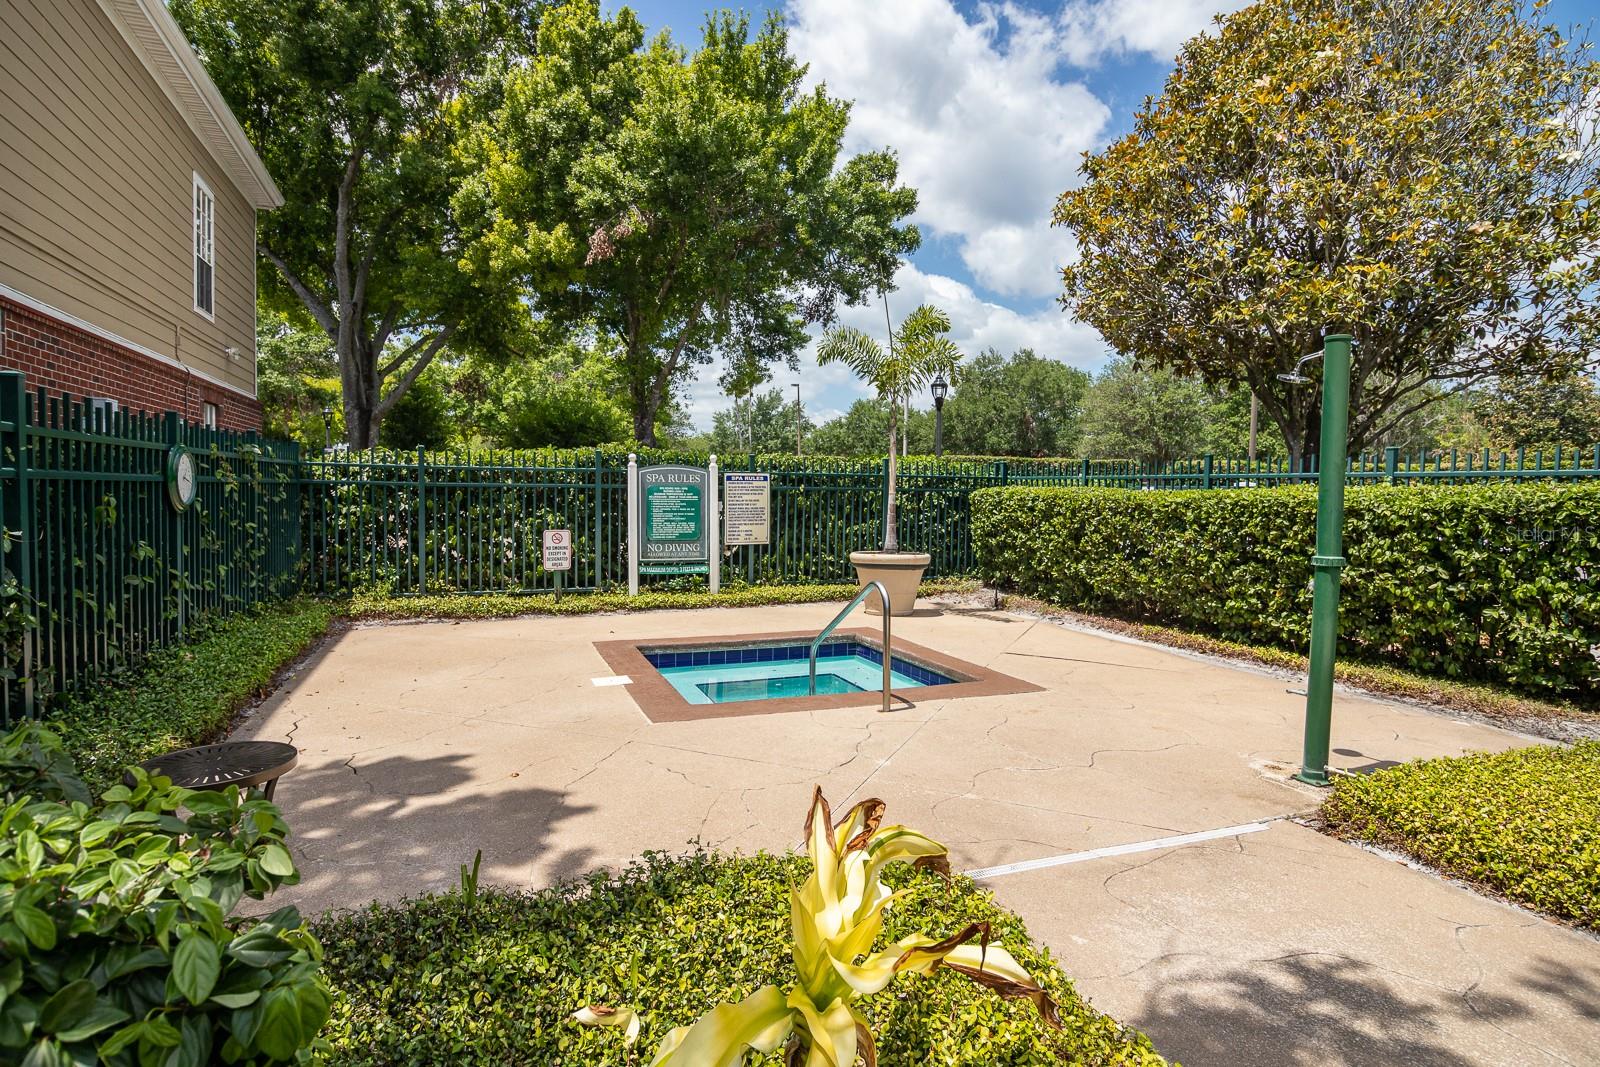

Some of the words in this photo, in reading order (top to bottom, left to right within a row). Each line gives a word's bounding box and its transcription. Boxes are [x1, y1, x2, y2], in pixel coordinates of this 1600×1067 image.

[646, 473, 665, 483] SPA
[668, 473, 701, 483] RULES
[647, 544, 663, 552] NO
[665, 544, 700, 552] DIVING
